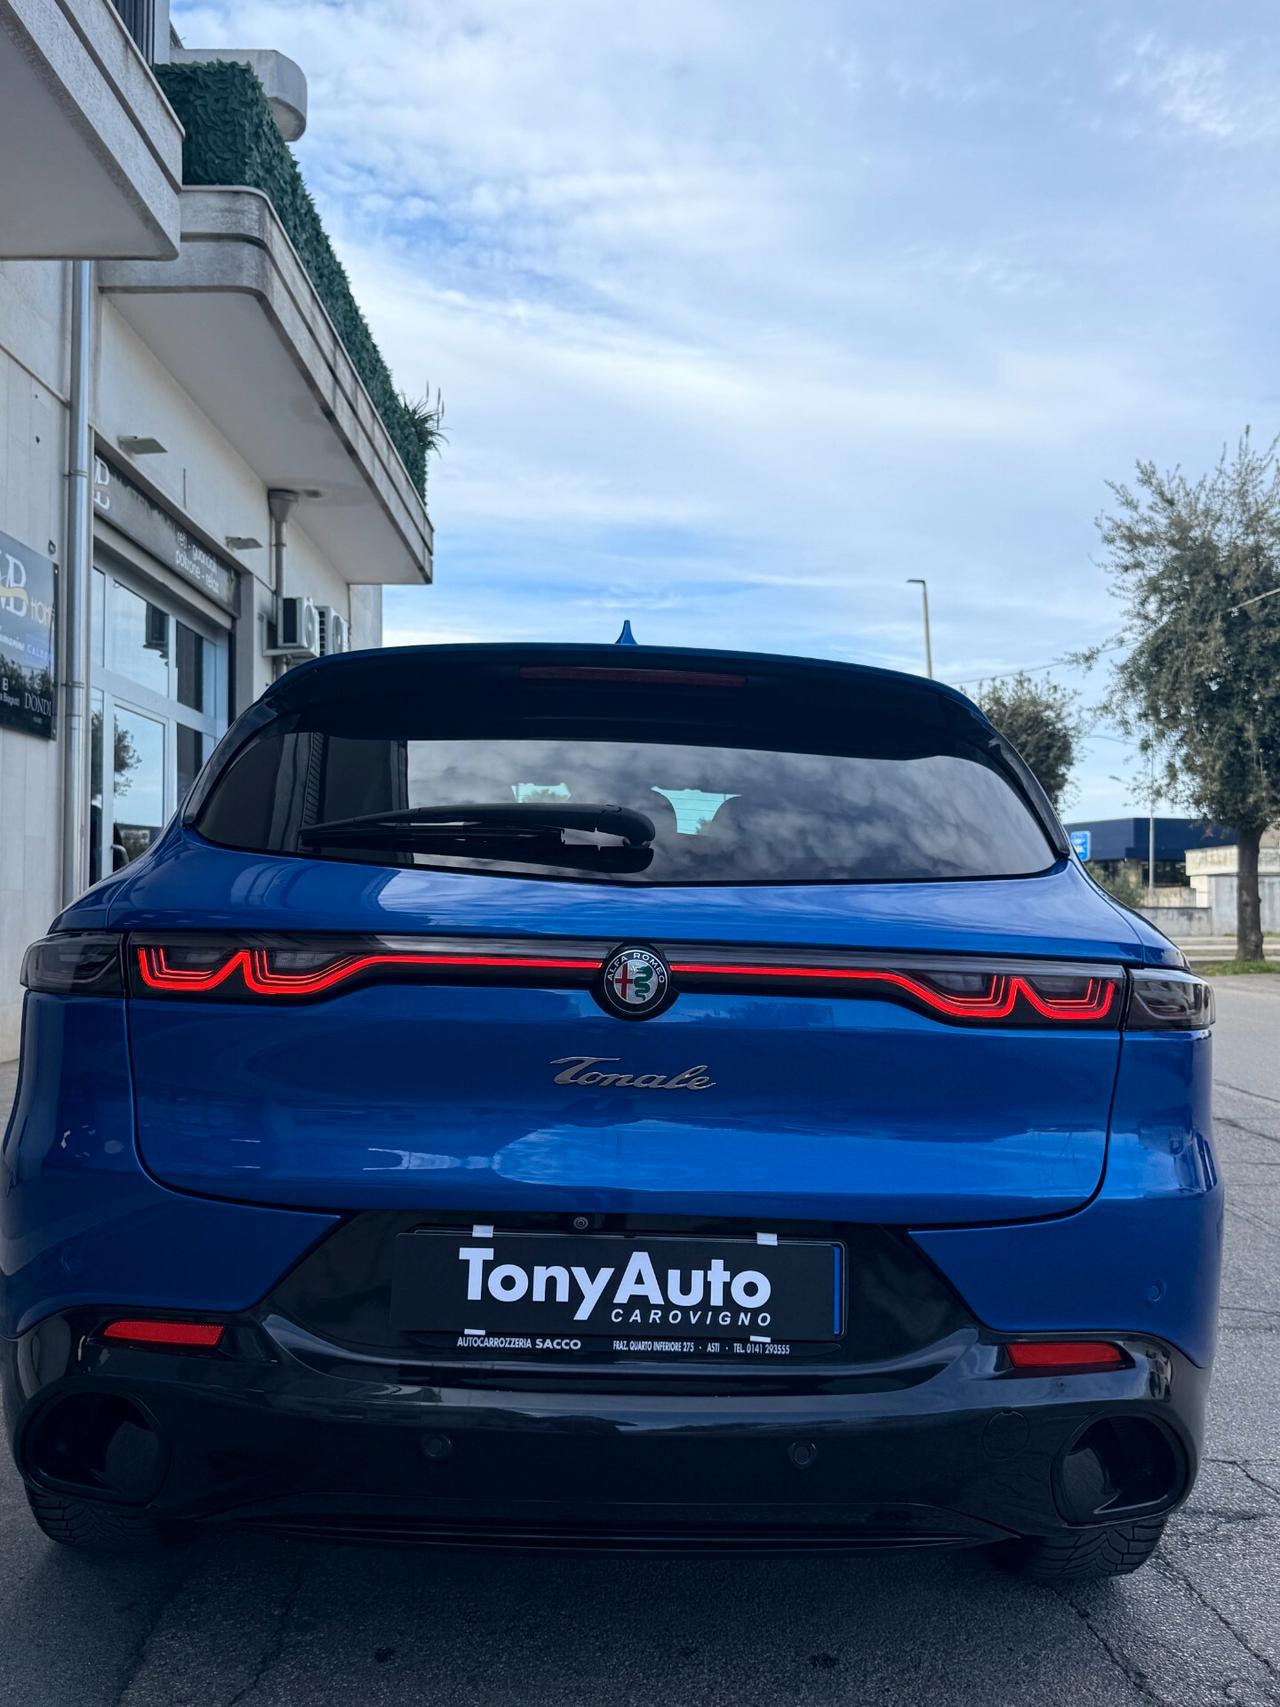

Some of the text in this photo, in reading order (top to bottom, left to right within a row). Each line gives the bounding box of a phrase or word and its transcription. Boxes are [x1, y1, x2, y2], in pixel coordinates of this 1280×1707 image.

[24, 692, 52, 717] DONDI
[607, 952, 665, 984] ALFA ROMEO
[550, 1056, 716, 1090] Tonale
[458, 1247, 772, 1321] TonyAuto
[611, 1308, 771, 1327] CAROVIGNO
[457, 1336, 582, 1350] AUTOCARROZZERIA SACCO
[612, 1340, 790, 1355] FRAZ. QUARTO INFERIORE 275 ASTI TEL. 0141 293555
